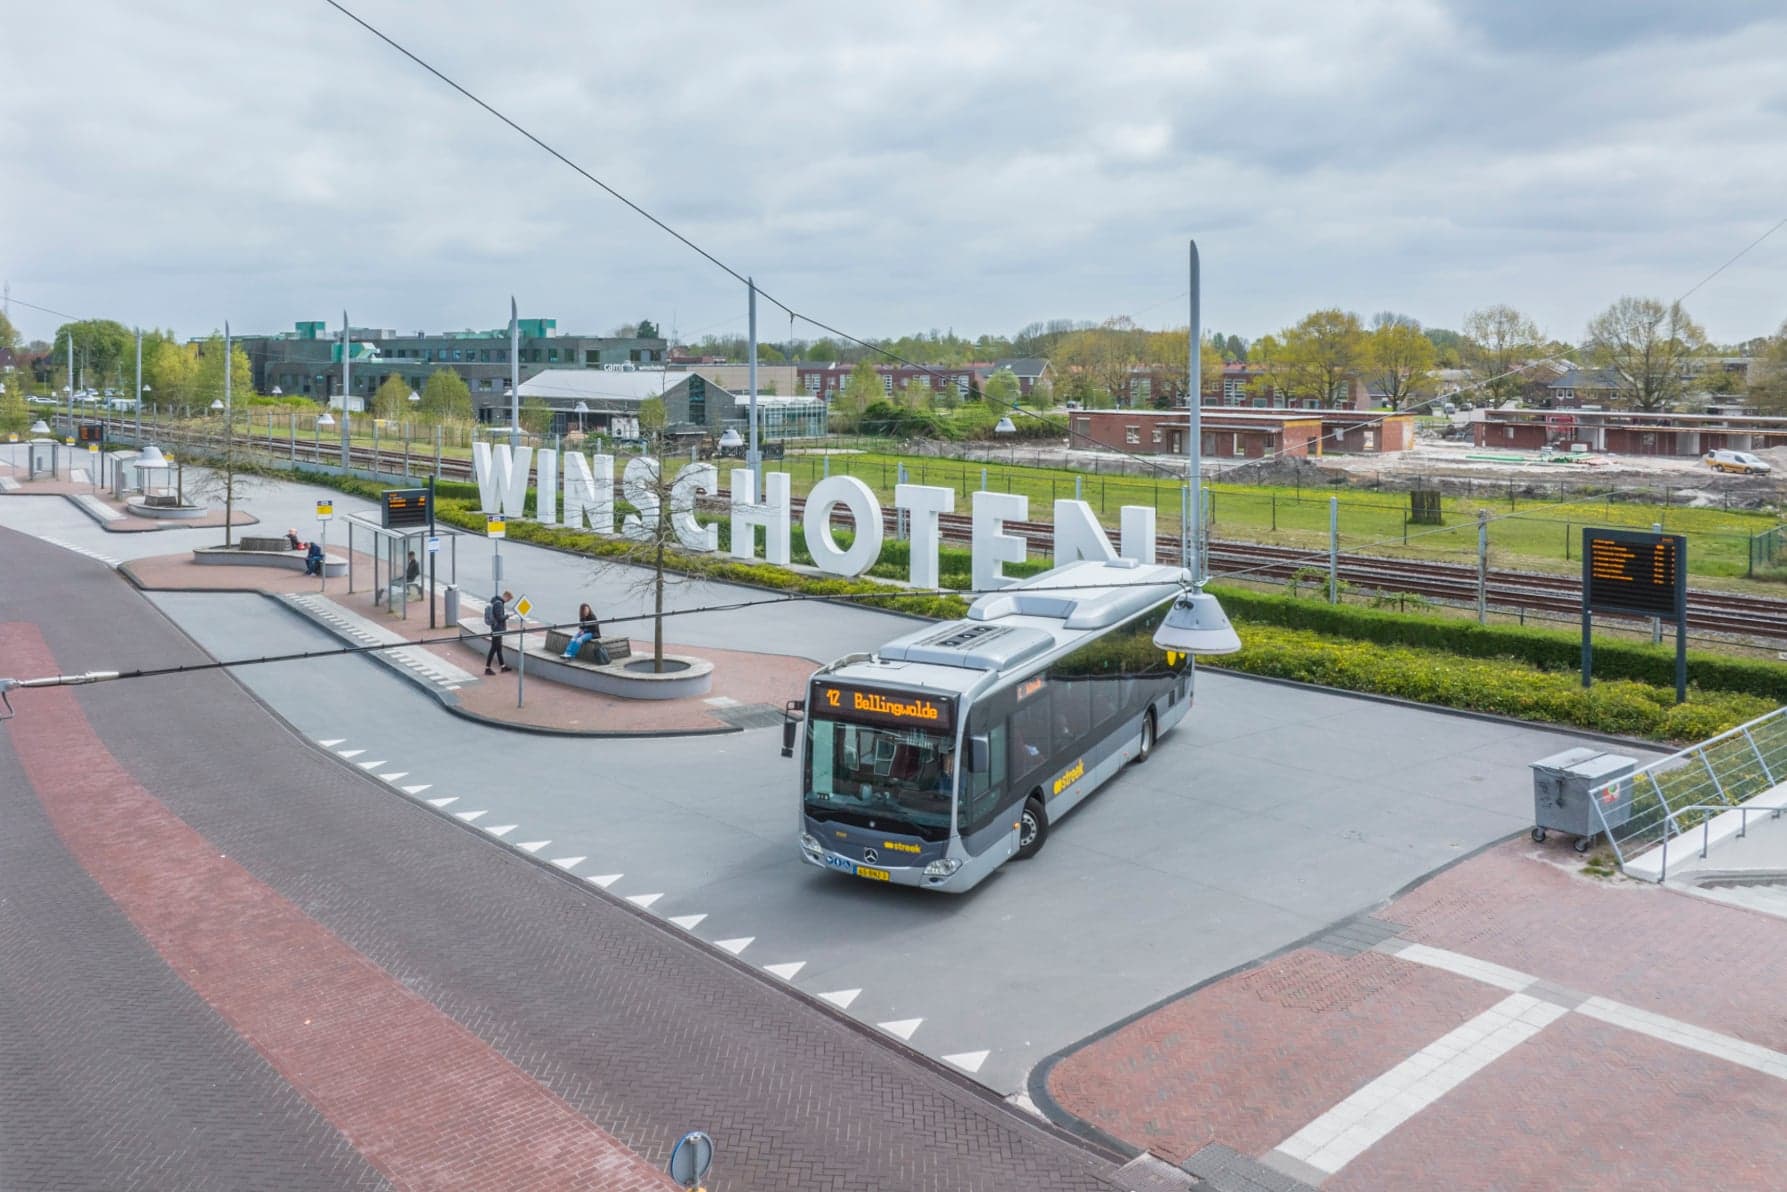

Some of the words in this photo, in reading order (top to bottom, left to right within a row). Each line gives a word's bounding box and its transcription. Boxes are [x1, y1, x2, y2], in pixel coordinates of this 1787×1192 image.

[472, 441, 1157, 592] WINSCHOTEN
[826, 689, 840, 706] 12
[854, 692, 938, 719] Bellingwolde
